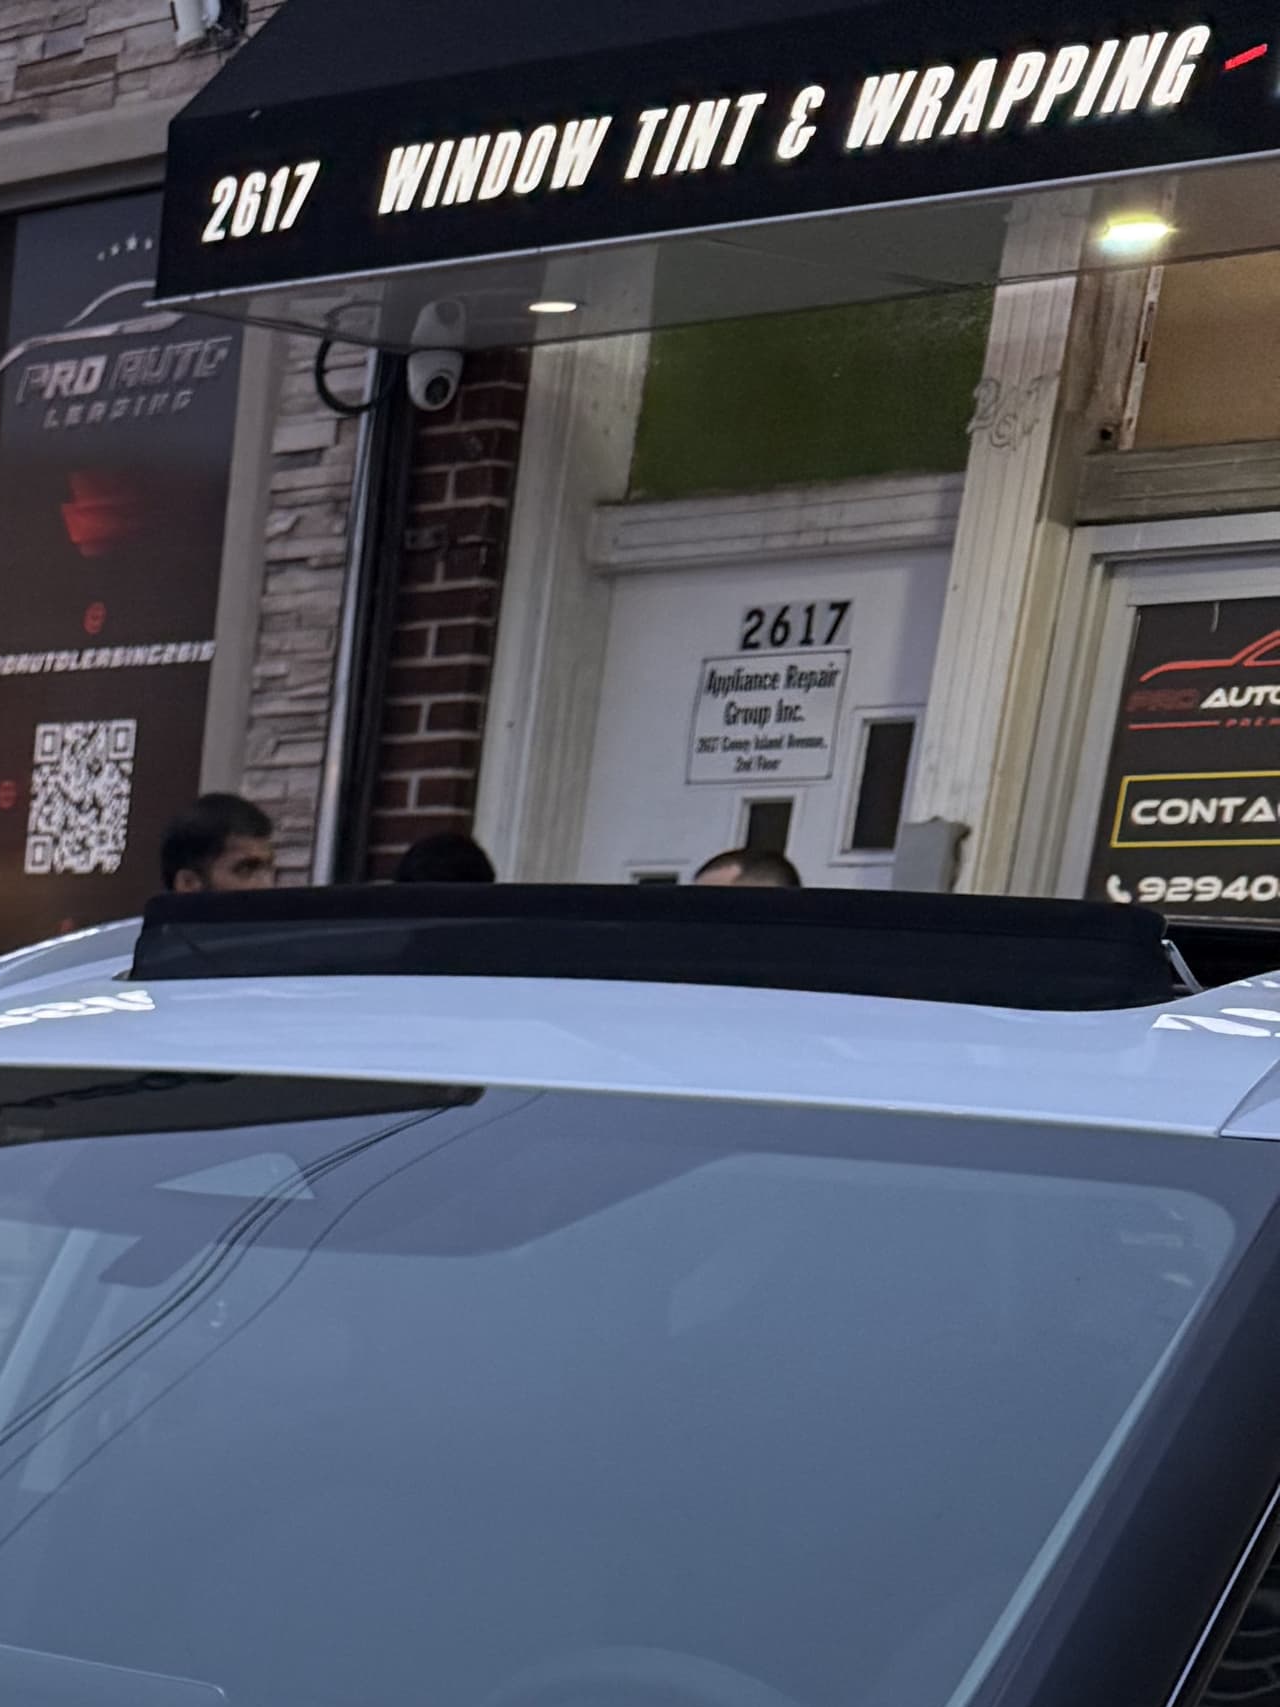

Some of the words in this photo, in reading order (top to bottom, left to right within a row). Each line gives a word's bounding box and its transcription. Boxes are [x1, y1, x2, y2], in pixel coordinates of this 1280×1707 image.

[377, 116, 613, 216] WINDOW
[624, 92, 766, 181] TINT
[776, 85, 826, 161] &
[845, 24, 1211, 150] WRAPPING
[201, 160, 320, 244] 2617
[15, 355, 108, 405] PRO
[108, 335, 233, 392] AUTO
[740, 601, 852, 650] 2617
[705, 667, 781, 698] Appliance
[783, 662, 840, 693] Repair
[723, 700, 772, 728] Group
[775, 698, 806, 723] Inc.
[1130, 796, 1280, 826] CONTA
[1137, 874, 1280, 902] 92940
